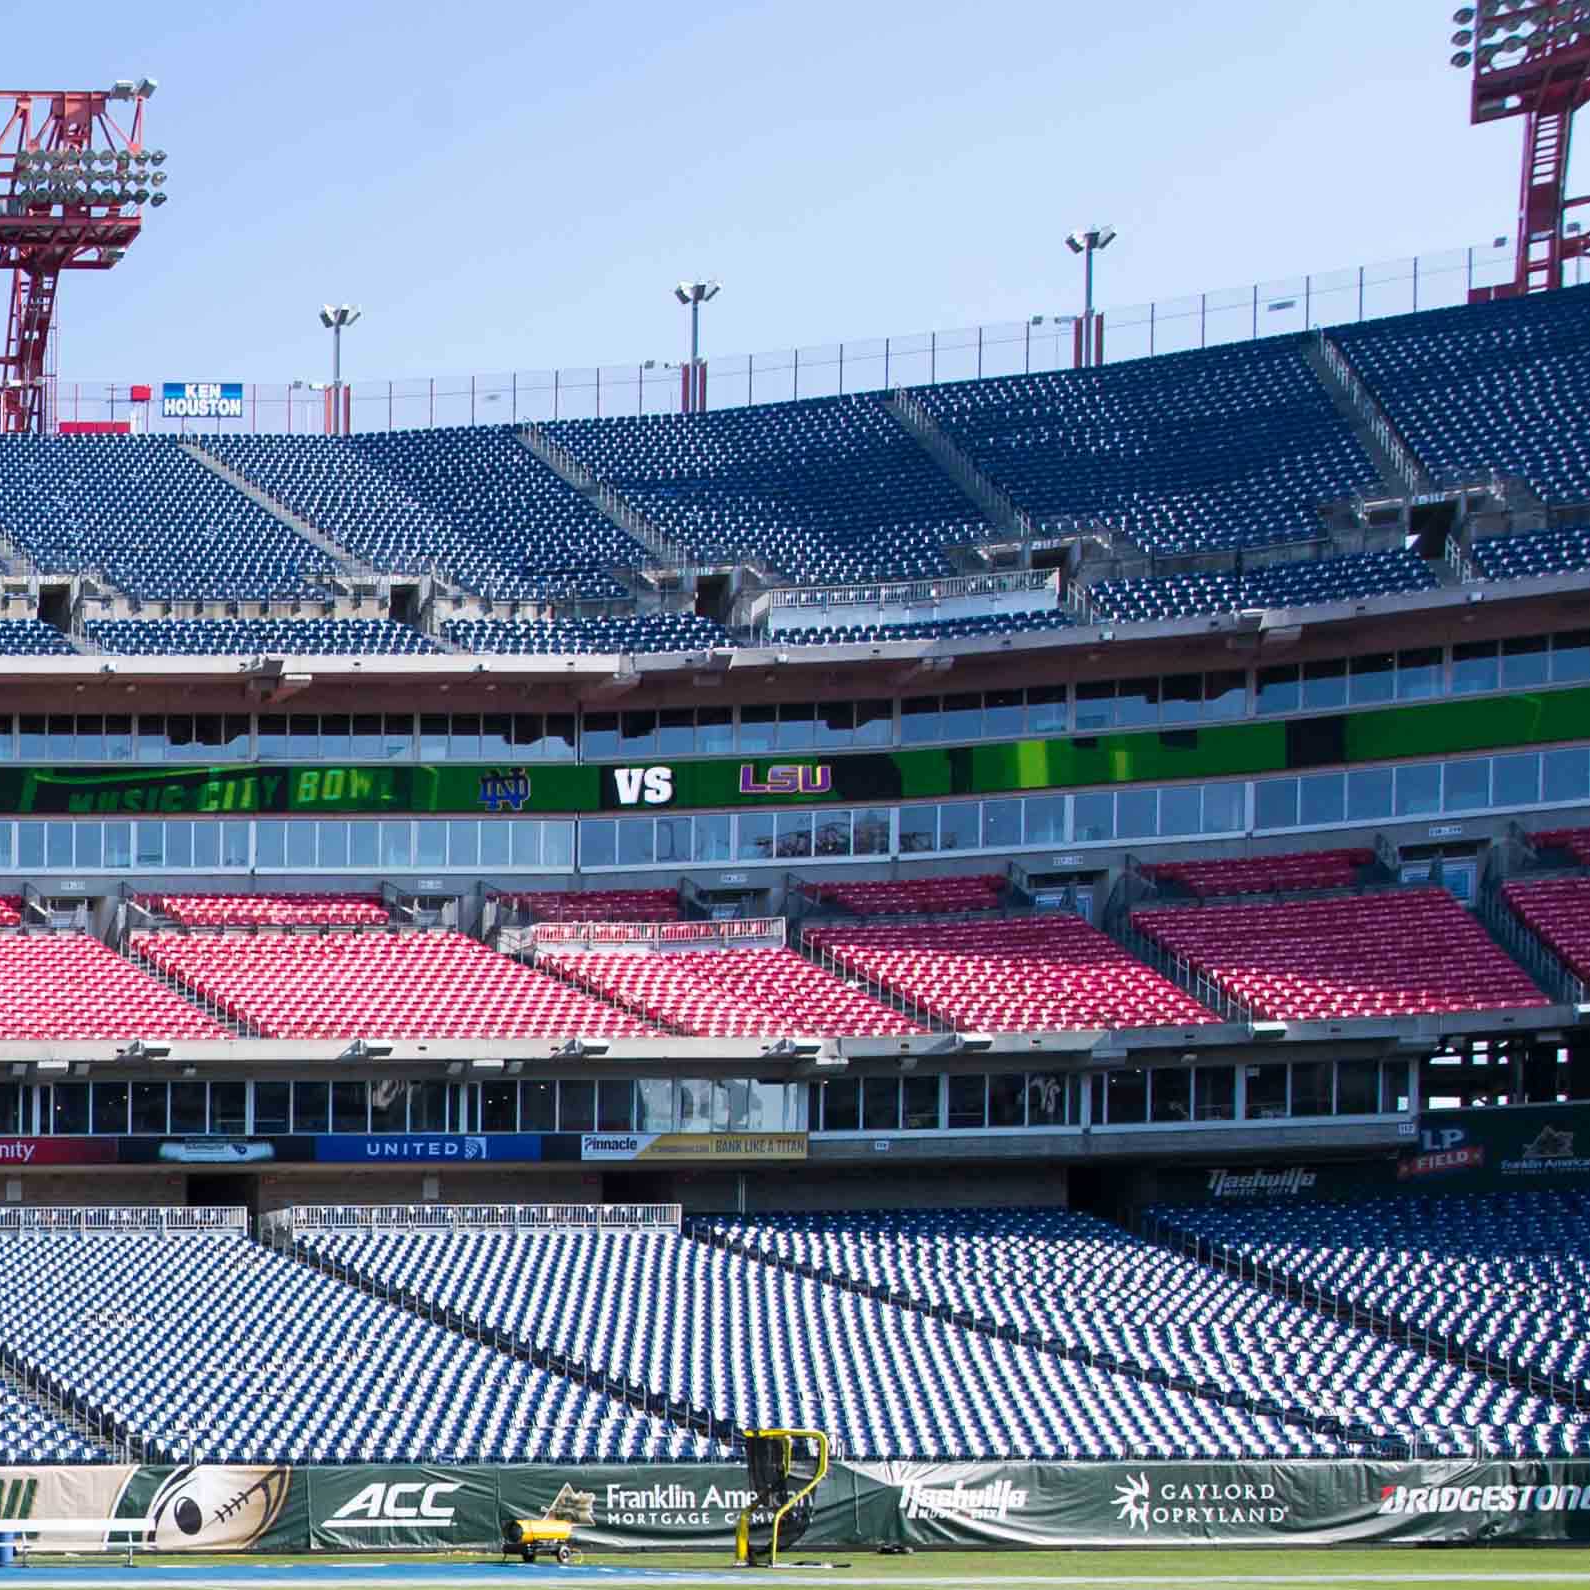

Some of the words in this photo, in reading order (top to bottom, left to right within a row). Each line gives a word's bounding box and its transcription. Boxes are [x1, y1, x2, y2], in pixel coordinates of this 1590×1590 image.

[185, 383, 220, 399] KEN
[163, 398, 242, 416] HOUSTON
[614, 766, 675, 805] VS
[739, 763, 832, 794] LSU
[366, 1141, 458, 1155] UNITED
[584, 1136, 638, 1152] Pinnacle
[715, 1139, 742, 1153] BANK
[744, 1139, 766, 1153] LIKE
[767, 1139, 775, 1153] A
[776, 1139, 805, 1153] TITAN
[1421, 1129, 1465, 1151] LP
[1416, 1149, 1470, 1170] FIELD
[333, 1483, 463, 1518] ACC
[606, 1483, 696, 1508] Franklin
[1160, 1484, 1276, 1500] GAYLORD
[607, 1512, 710, 1525] MORTGAGE
